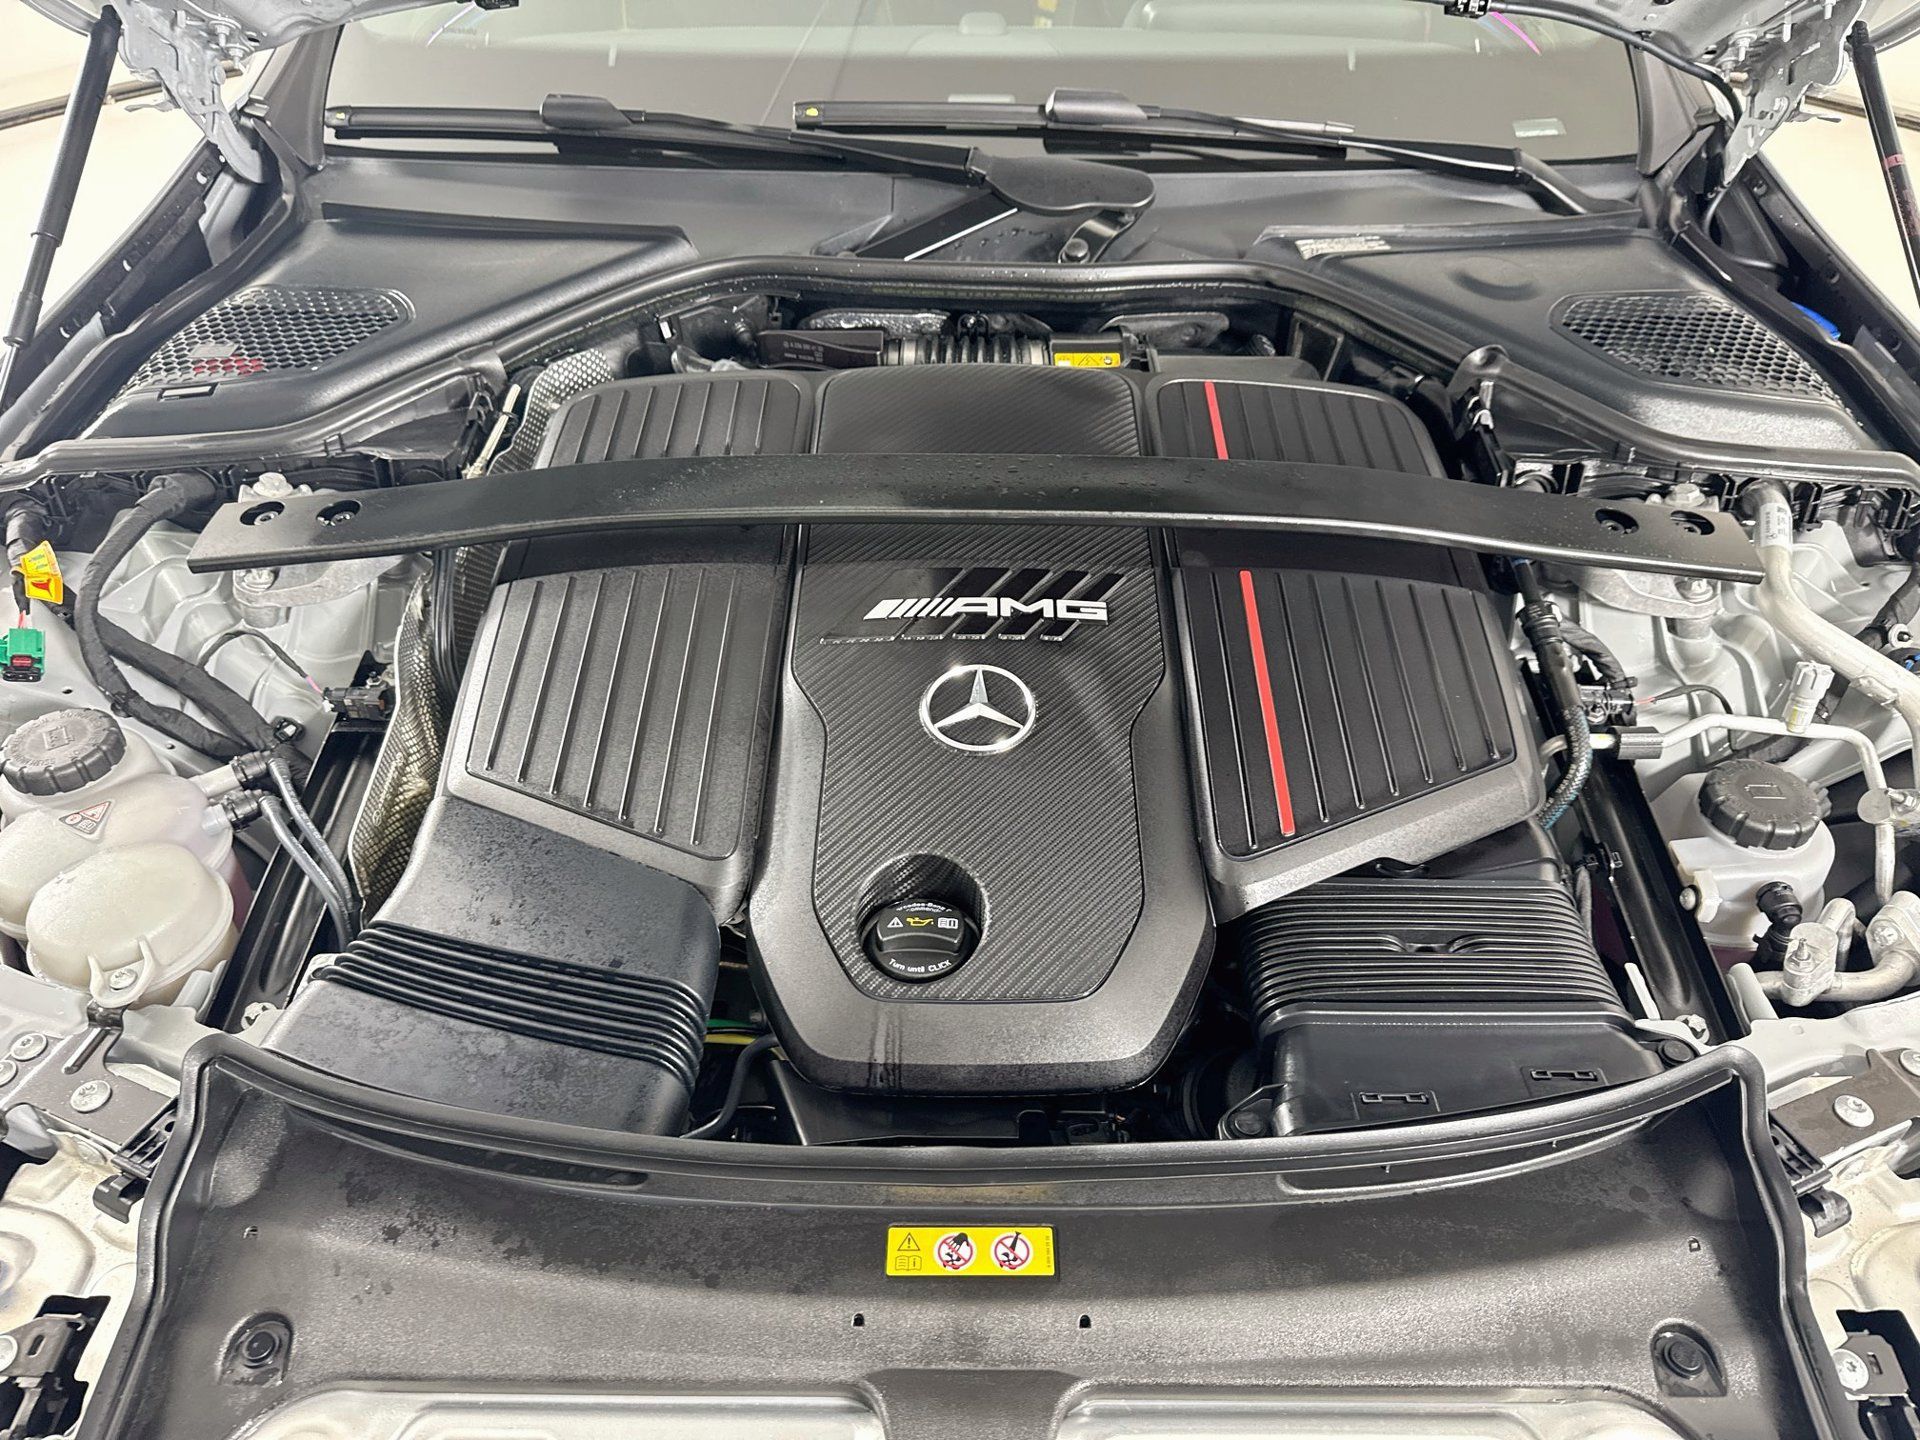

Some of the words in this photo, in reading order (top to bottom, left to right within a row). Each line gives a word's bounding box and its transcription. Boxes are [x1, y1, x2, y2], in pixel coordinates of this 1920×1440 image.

[941, 597, 1108, 622] AMG
[896, 902, 946, 911] rcedes-Benz
[888, 958, 906, 970] Turn
[928, 959, 952, 972] CLICK
